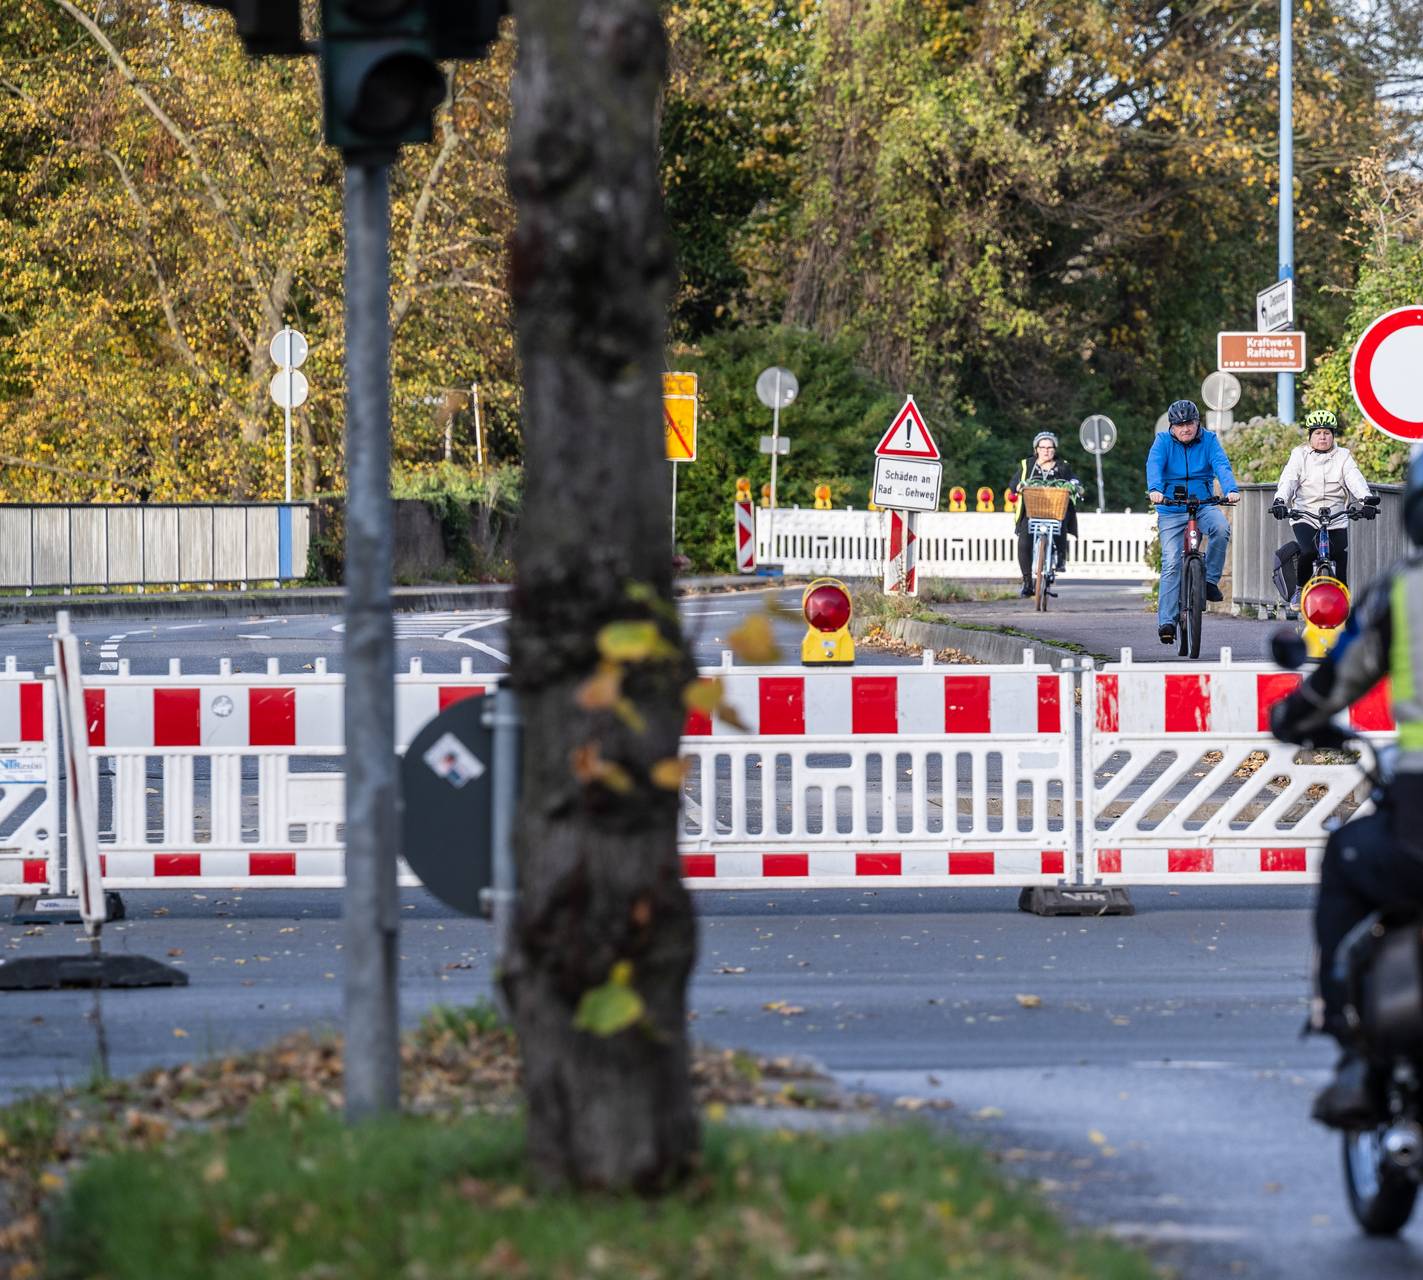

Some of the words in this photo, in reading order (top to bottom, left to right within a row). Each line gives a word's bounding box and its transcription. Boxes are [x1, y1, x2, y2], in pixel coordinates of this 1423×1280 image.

[1246, 337, 1293, 348] Kraftwerk
[1246, 348, 1296, 360] Raffelberg
[885, 469, 918, 482] Schäden
[921, 475, 931, 484] an
[878, 484, 893, 495] Rad
[904, 487, 935, 502] Gehweg
